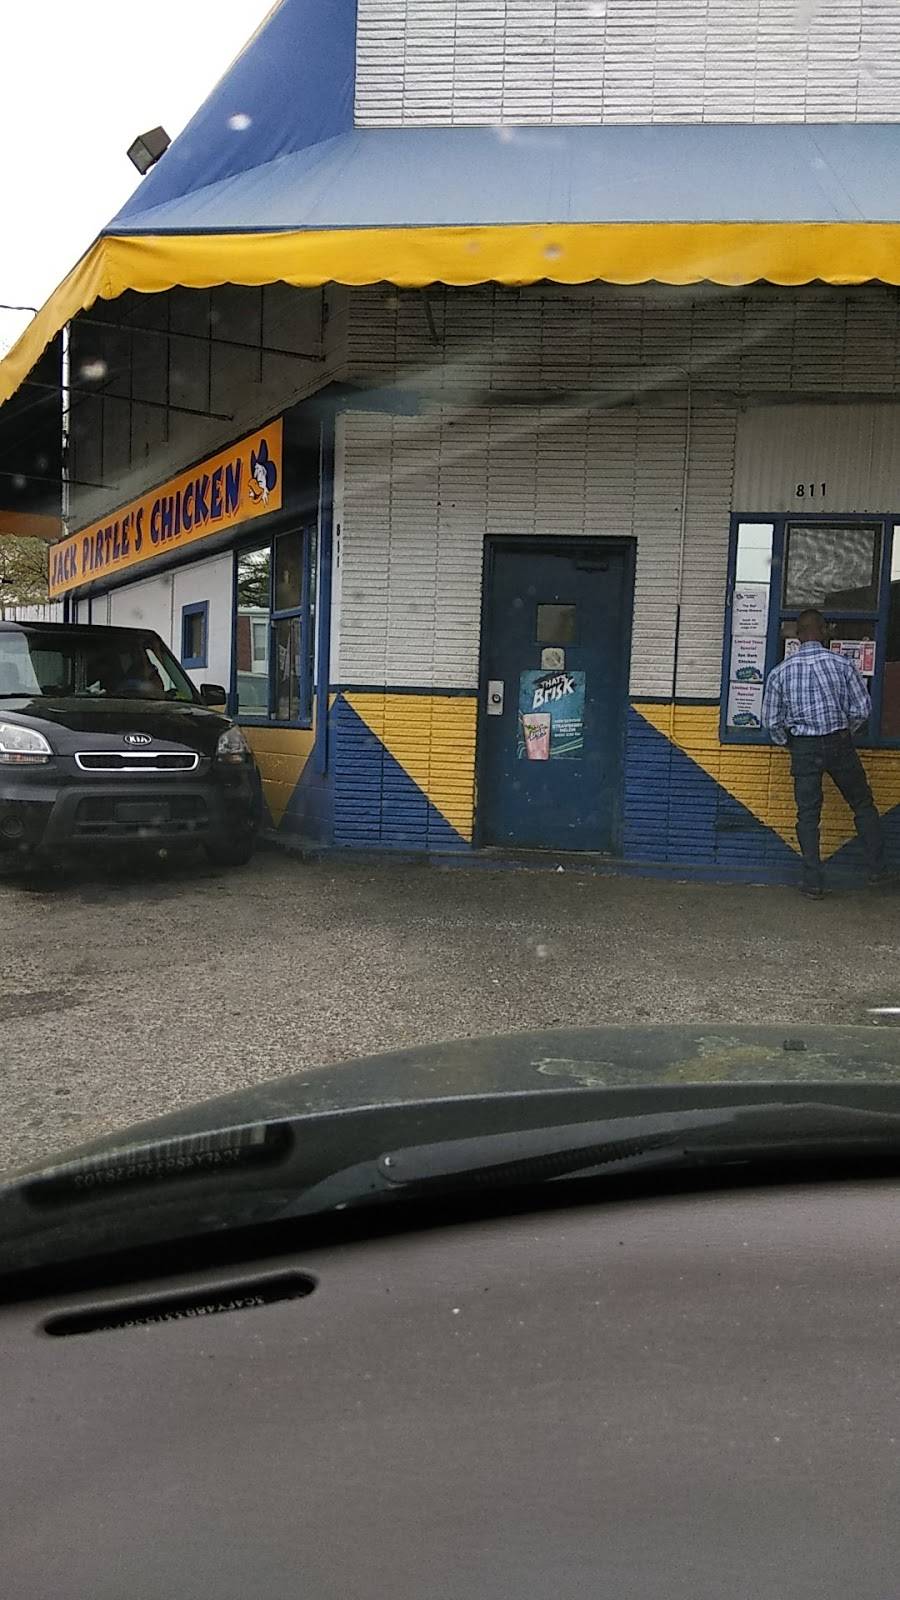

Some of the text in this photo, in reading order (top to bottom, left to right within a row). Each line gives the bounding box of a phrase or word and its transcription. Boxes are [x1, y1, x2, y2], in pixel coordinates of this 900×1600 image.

[796, 483, 826, 497] 811
[51, 457, 244, 587] JACK PIRTLE'S CHICKEN
[540, 673, 567, 688] THAT'S
[129, 735, 149, 743] KIA
